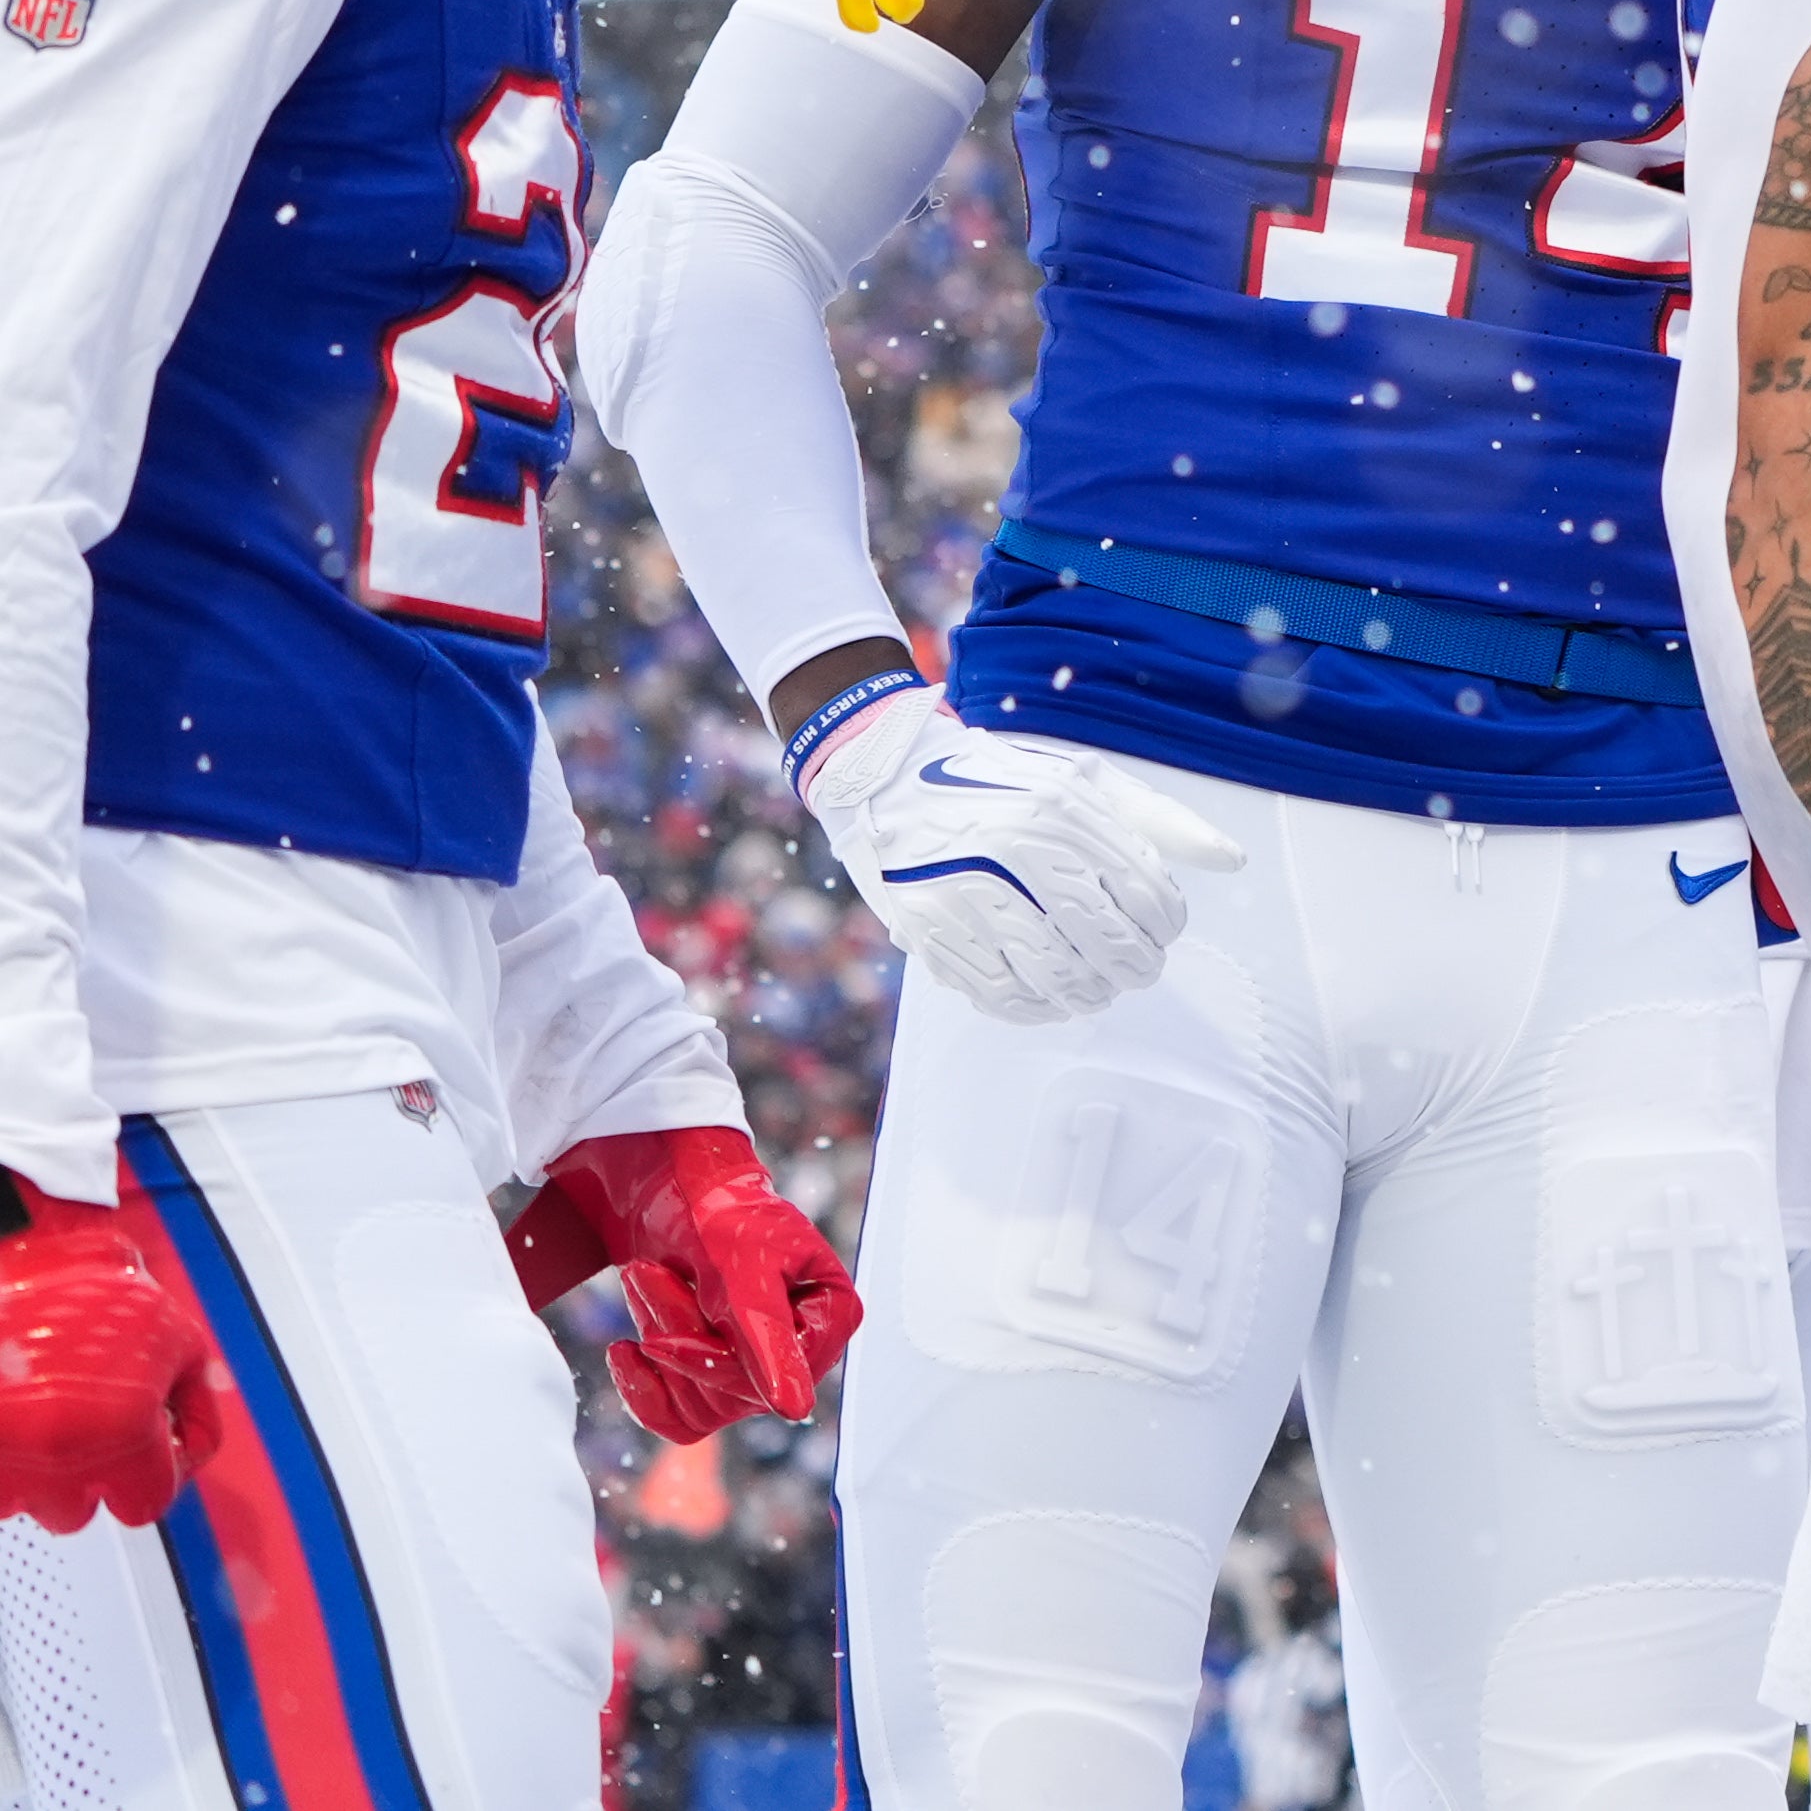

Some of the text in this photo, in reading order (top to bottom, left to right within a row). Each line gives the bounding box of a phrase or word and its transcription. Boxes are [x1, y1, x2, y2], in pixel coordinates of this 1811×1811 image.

[866, 672, 914, 694] SEEK
[820, 687, 868, 728] FIRST
[792, 724, 819, 757] HIS
[1035, 1101, 1242, 1340] 14
